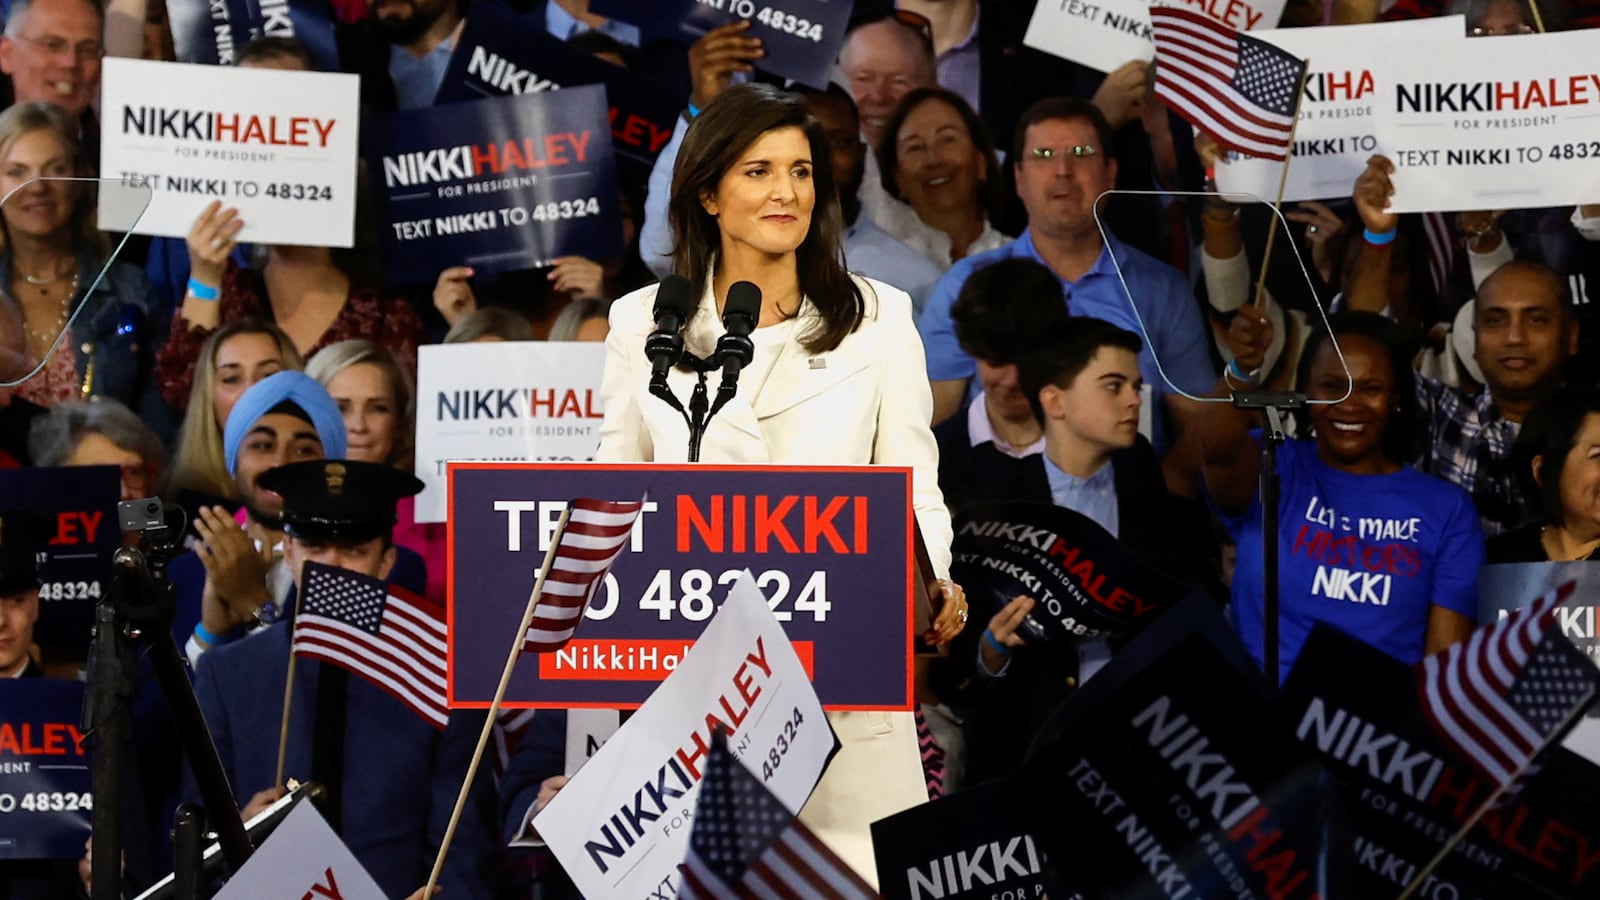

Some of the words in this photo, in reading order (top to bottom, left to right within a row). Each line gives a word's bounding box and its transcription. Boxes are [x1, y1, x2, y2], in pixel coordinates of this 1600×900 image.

[756, 6, 823, 43] 48324
[1059, 0, 1100, 21] TEXT
[1103, 11, 1152, 42] NIKK
[467, 45, 561, 96] NIKK
[1453, 119, 1480, 130] FOR
[1486, 114, 1558, 129] PRESIDENT
[174, 148, 200, 159] FOR
[204, 149, 276, 162] PRESIDENT
[1290, 138, 1344, 158] NIKKI
[1350, 134, 1377, 152] TO
[1396, 150, 1440, 167] TEXT
[1447, 149, 1511, 166] NIKKI
[1516, 146, 1543, 164] TO
[119, 171, 161, 191] TEXT
[166, 175, 227, 197] NIKKI
[233, 180, 258, 198] TO
[264, 182, 333, 201] 48324
[437, 183, 463, 199] FOR
[466, 174, 538, 195] PRESIDENT
[392, 218, 431, 241] TEXT
[434, 209, 497, 237] NIKKI
[499, 205, 529, 228] TO
[532, 196, 600, 223] 48324
[488, 427, 513, 437] FOR
[494, 500, 658, 553] TET
[675, 494, 869, 555] NIKKI
[1358, 516, 1422, 543] MAKE
[1292, 524, 1424, 578] HISTORY
[38, 580, 102, 601] 48324
[638, 568, 832, 623] 4824
[981, 556, 1043, 595] NIKKI
[1040, 588, 1063, 617] TO
[1033, 552, 1089, 607] PRESIDENT
[1311, 565, 1393, 606] NIKKI
[761, 705, 804, 783] 48324
[20, 792, 94, 812] 48324
[662, 807, 693, 838] FOR
[1067, 756, 1126, 816] TEXT
[1115, 813, 1193, 900] NIKKI
[1402, 809, 1504, 872] PRESENT
